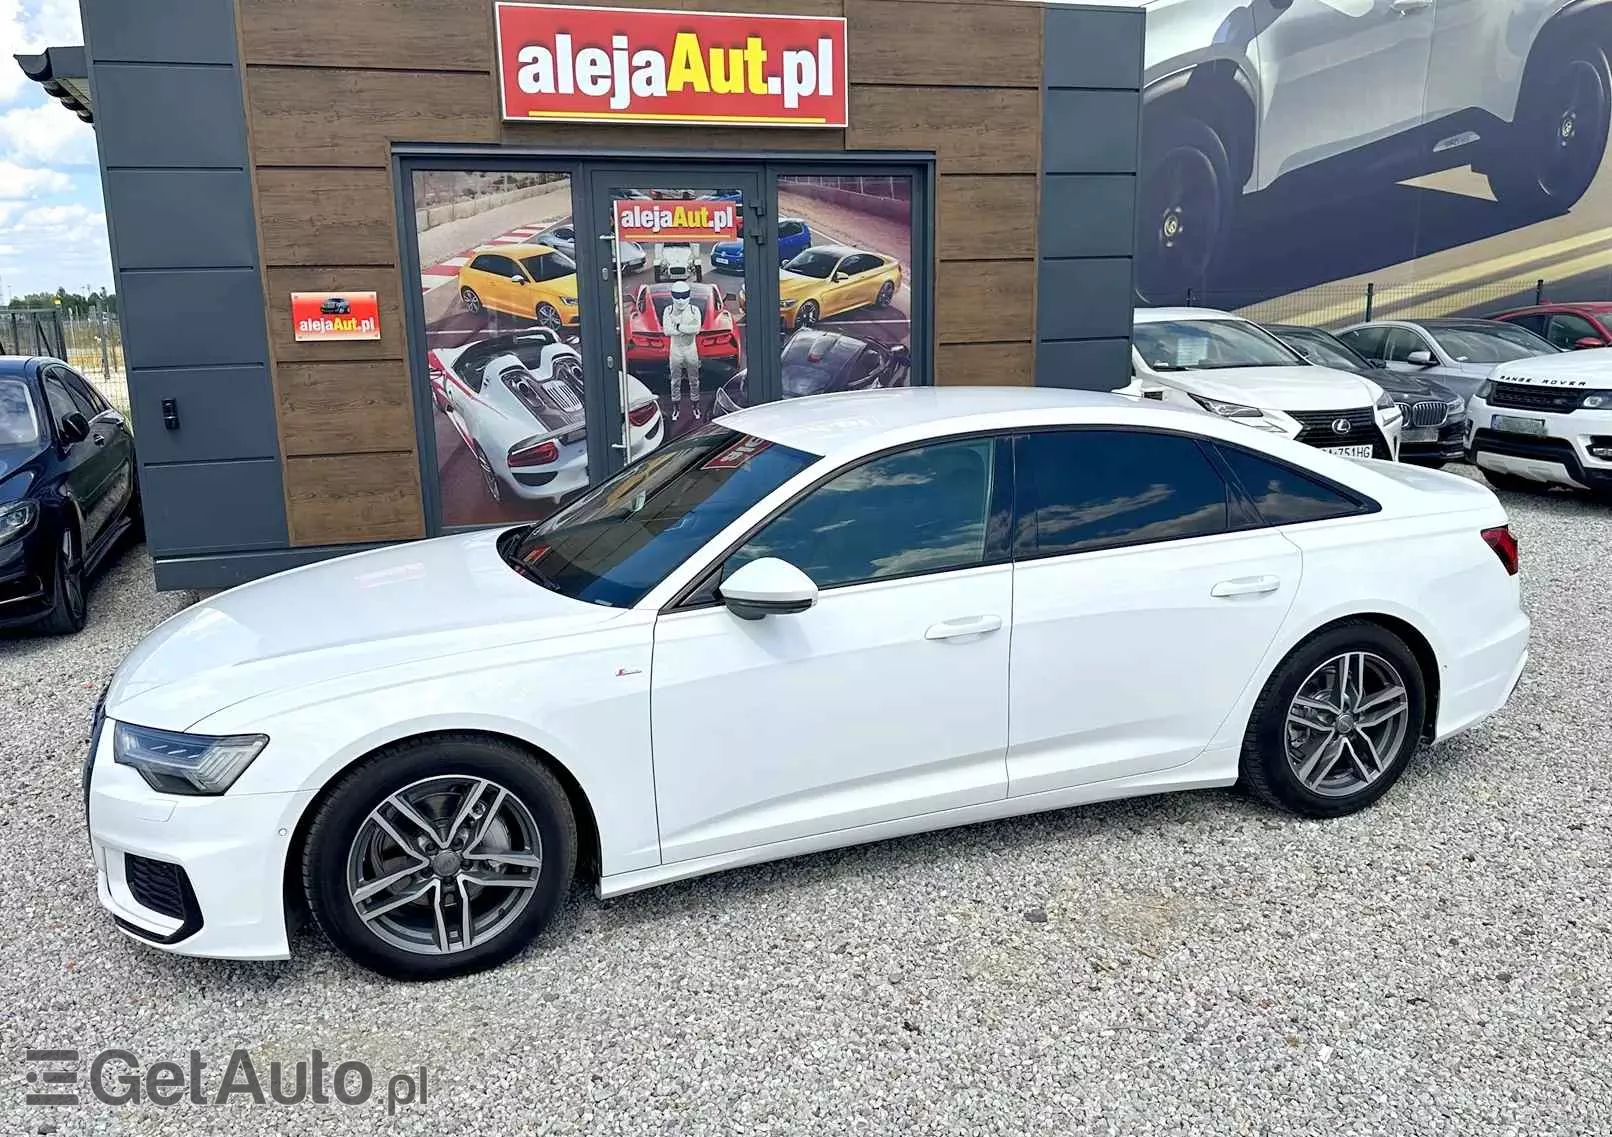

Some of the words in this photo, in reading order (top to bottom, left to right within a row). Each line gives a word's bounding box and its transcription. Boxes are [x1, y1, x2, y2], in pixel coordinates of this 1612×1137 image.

[517, 32, 833, 110] alejaAut.pl
[621, 206, 733, 232] alejaAut.pl
[299, 317, 375, 333] alejaAut.pl
[1499, 375, 1532, 383] RANGE
